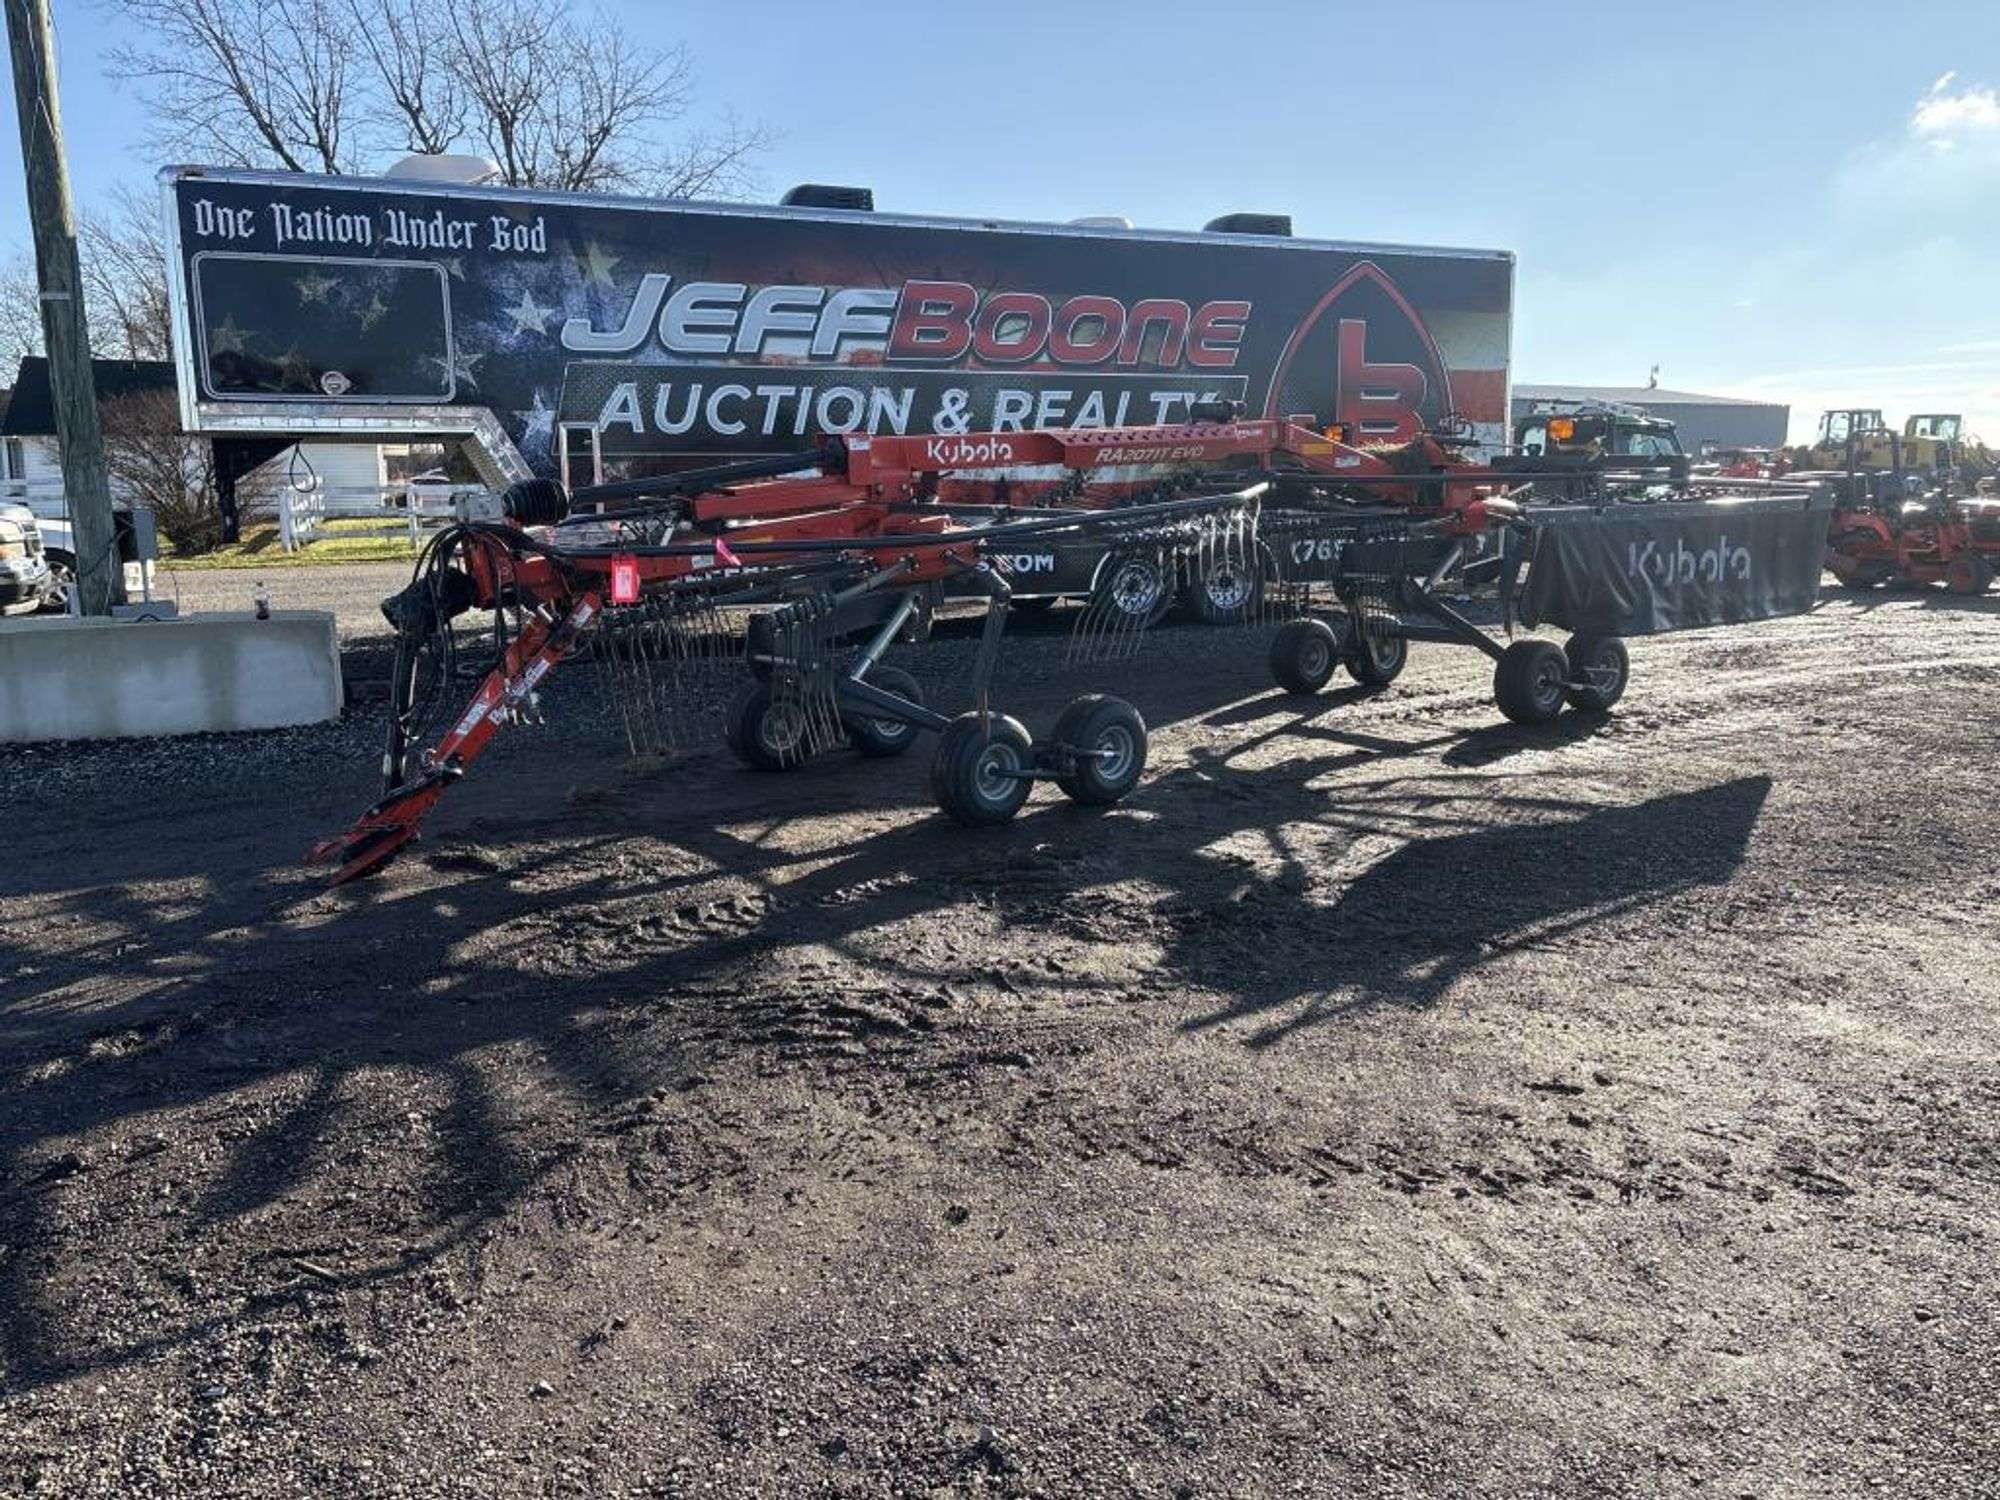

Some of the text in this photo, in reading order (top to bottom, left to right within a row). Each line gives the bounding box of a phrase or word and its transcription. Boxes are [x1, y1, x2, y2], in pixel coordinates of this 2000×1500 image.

[193, 199, 547, 253] One Nation Under God
[599, 383, 915, 434] AUCTION
[933, 388, 970, 433] &
[927, 437, 1013, 464] Kubota
[1627, 535, 1751, 586] Kubota
